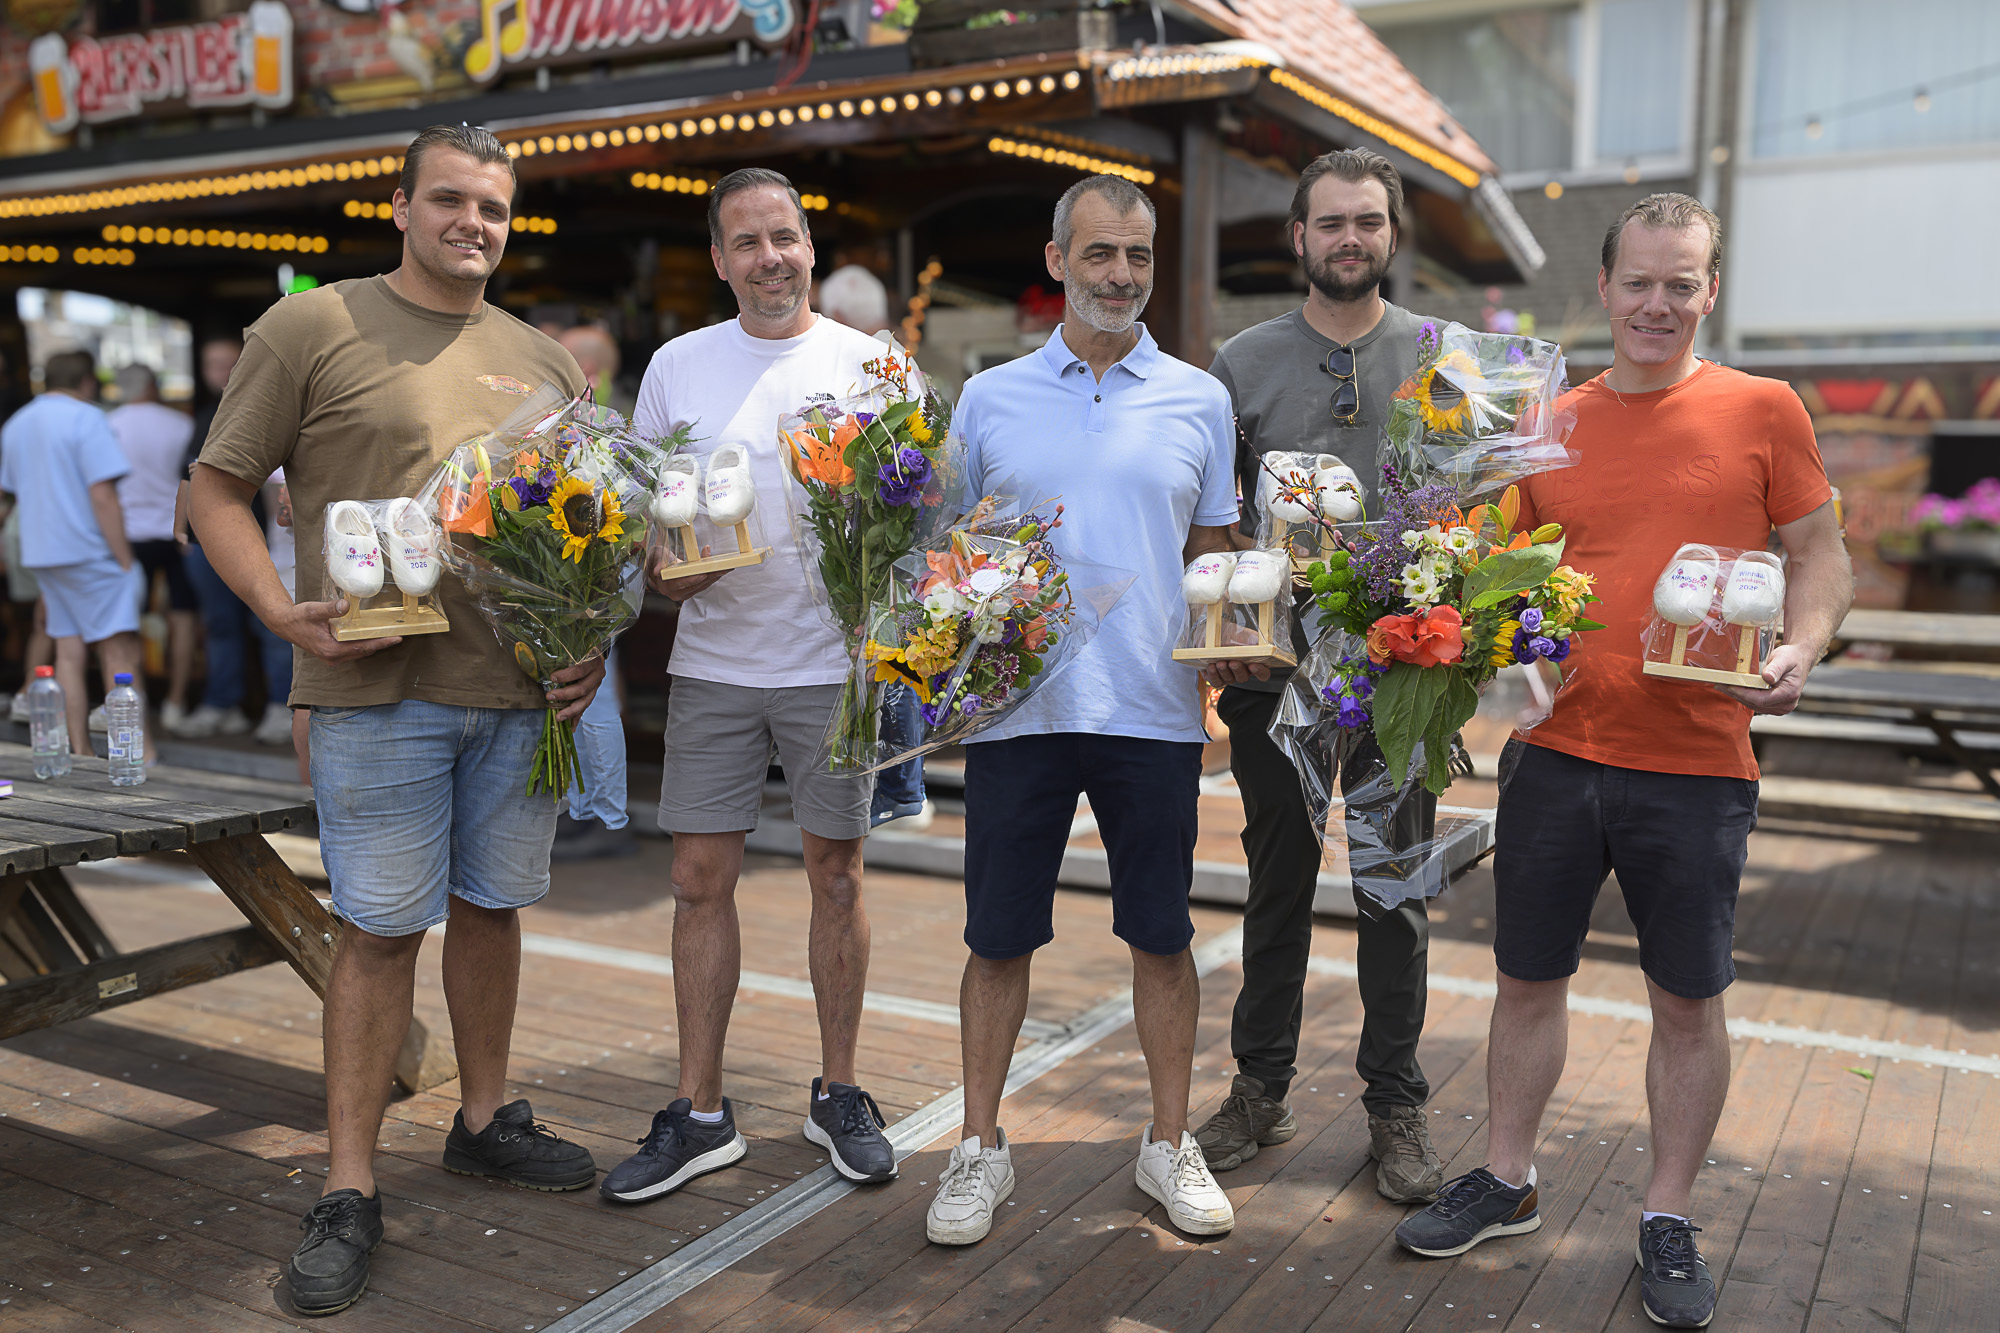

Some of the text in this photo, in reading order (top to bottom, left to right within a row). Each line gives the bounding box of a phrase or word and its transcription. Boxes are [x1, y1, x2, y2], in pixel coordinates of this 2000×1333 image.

[708, 478, 729, 487] Winaar
[1551, 454, 1722, 506] BOSS
[1642, 502, 1718, 515] BOSS
[410, 561, 428, 569] 2026
